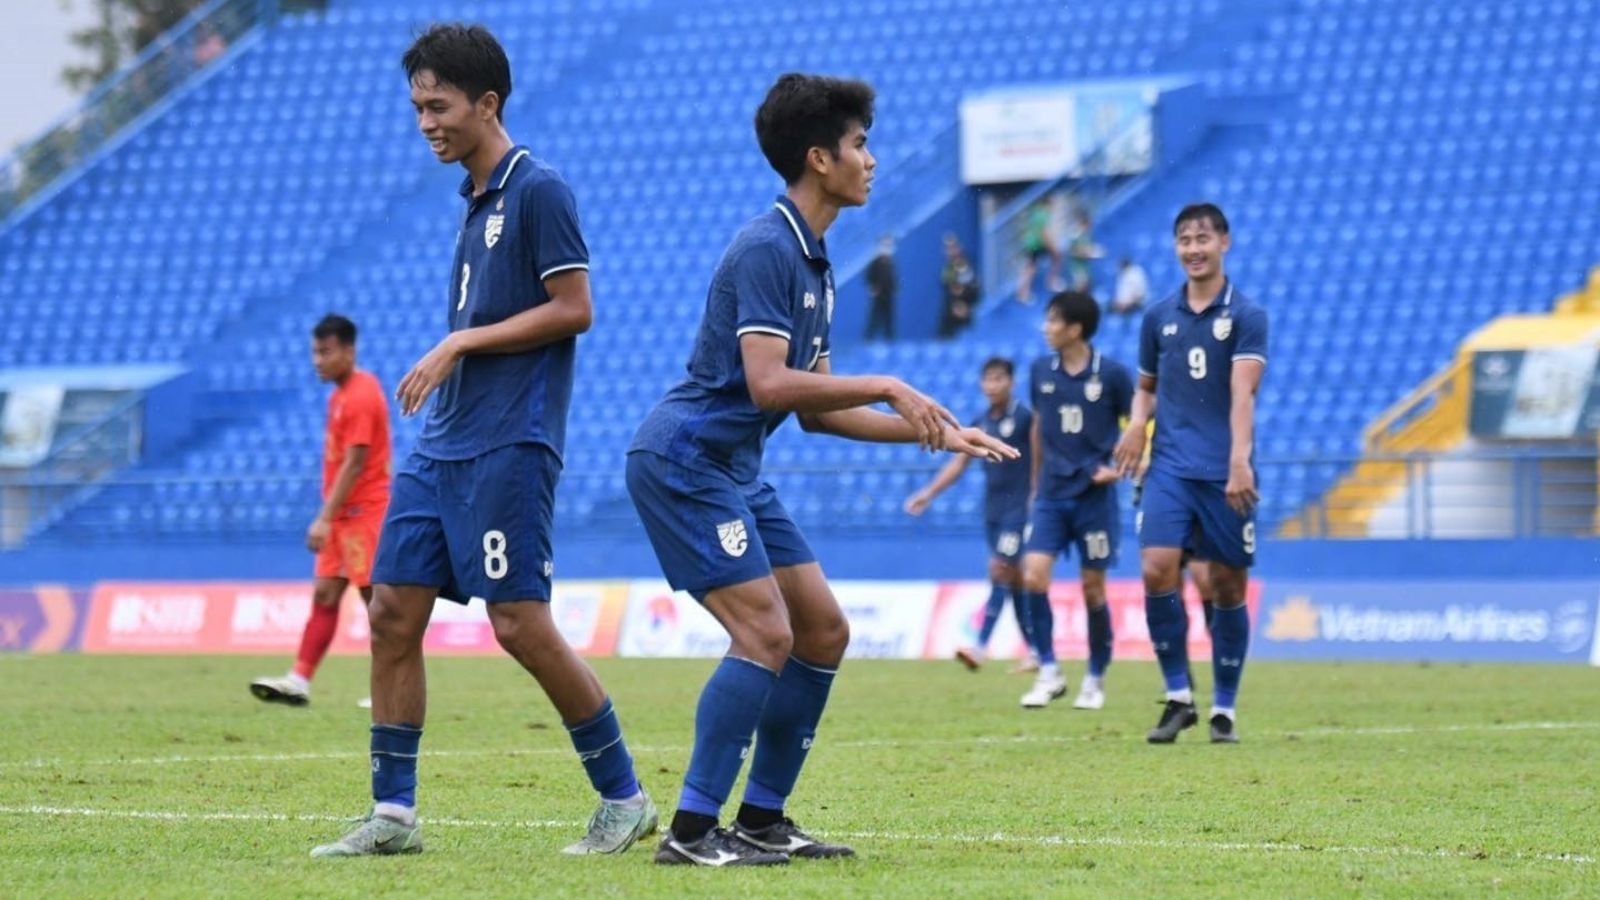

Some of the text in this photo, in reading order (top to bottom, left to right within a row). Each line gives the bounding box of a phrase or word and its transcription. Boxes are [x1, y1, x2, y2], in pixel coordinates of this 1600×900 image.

[807, 336, 822, 371] 7
[1188, 347, 1207, 379] 9
[1058, 404, 1083, 433] 10
[1084, 530, 1110, 560] 10
[1243, 522, 1256, 554] 9
[483, 530, 508, 579] 8
[1320, 603, 1549, 642] Vietnam Airlines
